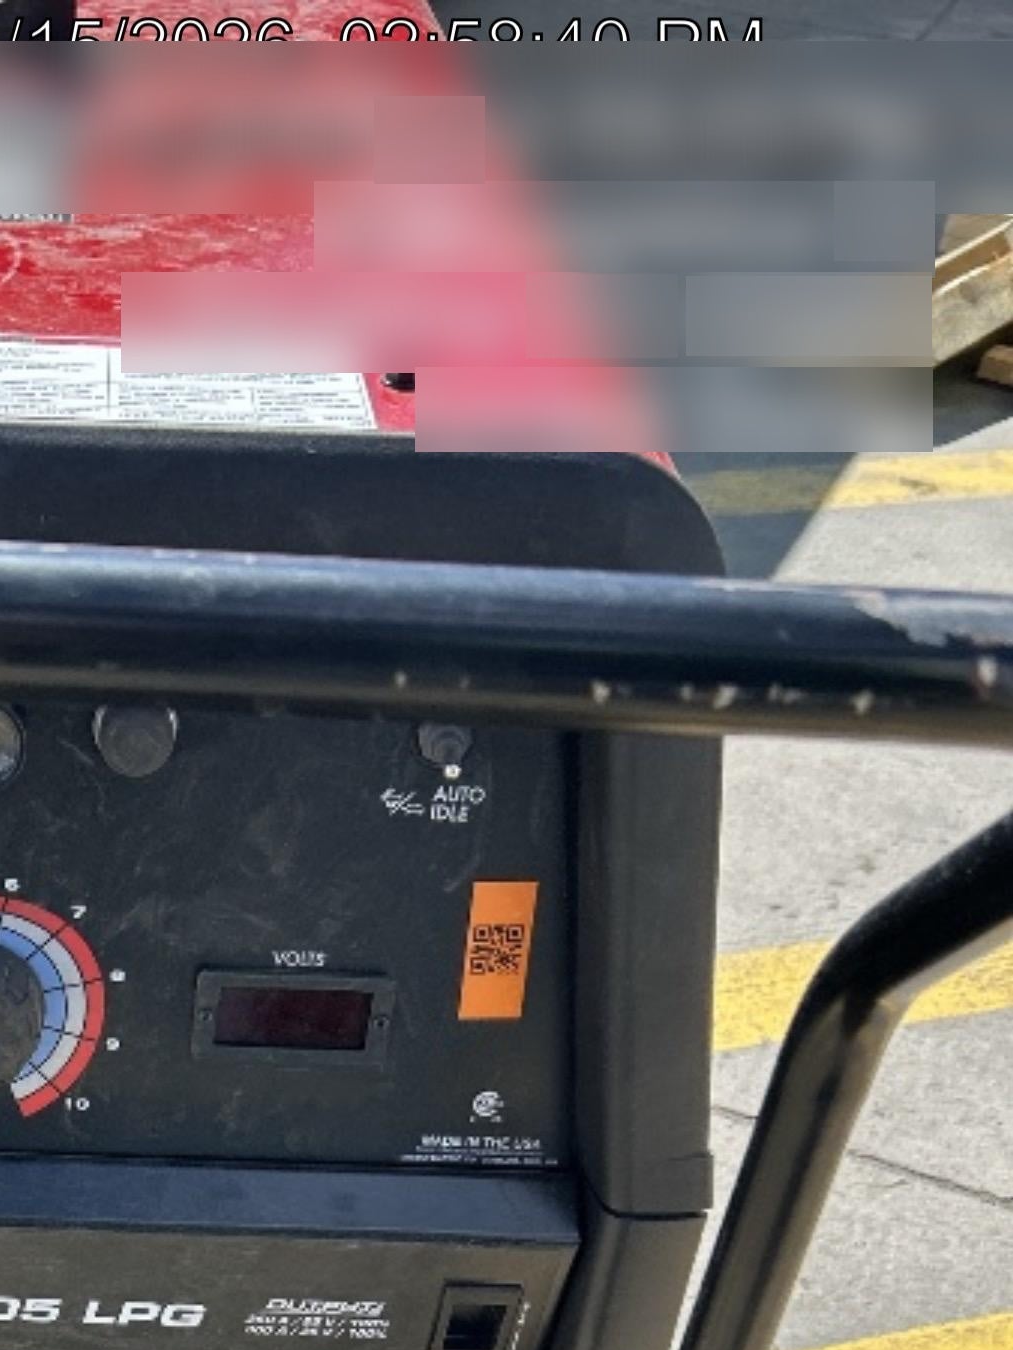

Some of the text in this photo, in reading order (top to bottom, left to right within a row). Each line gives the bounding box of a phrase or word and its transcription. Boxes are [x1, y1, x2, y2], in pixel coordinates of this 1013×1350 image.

[432, 784, 486, 805] AUTO
[430, 803, 468, 823] IDLE
[70, 905, 87, 919] 7
[271, 950, 326, 967] VOLTS
[106, 1038, 120, 1051] 9
[65, 1097, 90, 1111] 10
[82, 1299, 207, 1327] LPG
